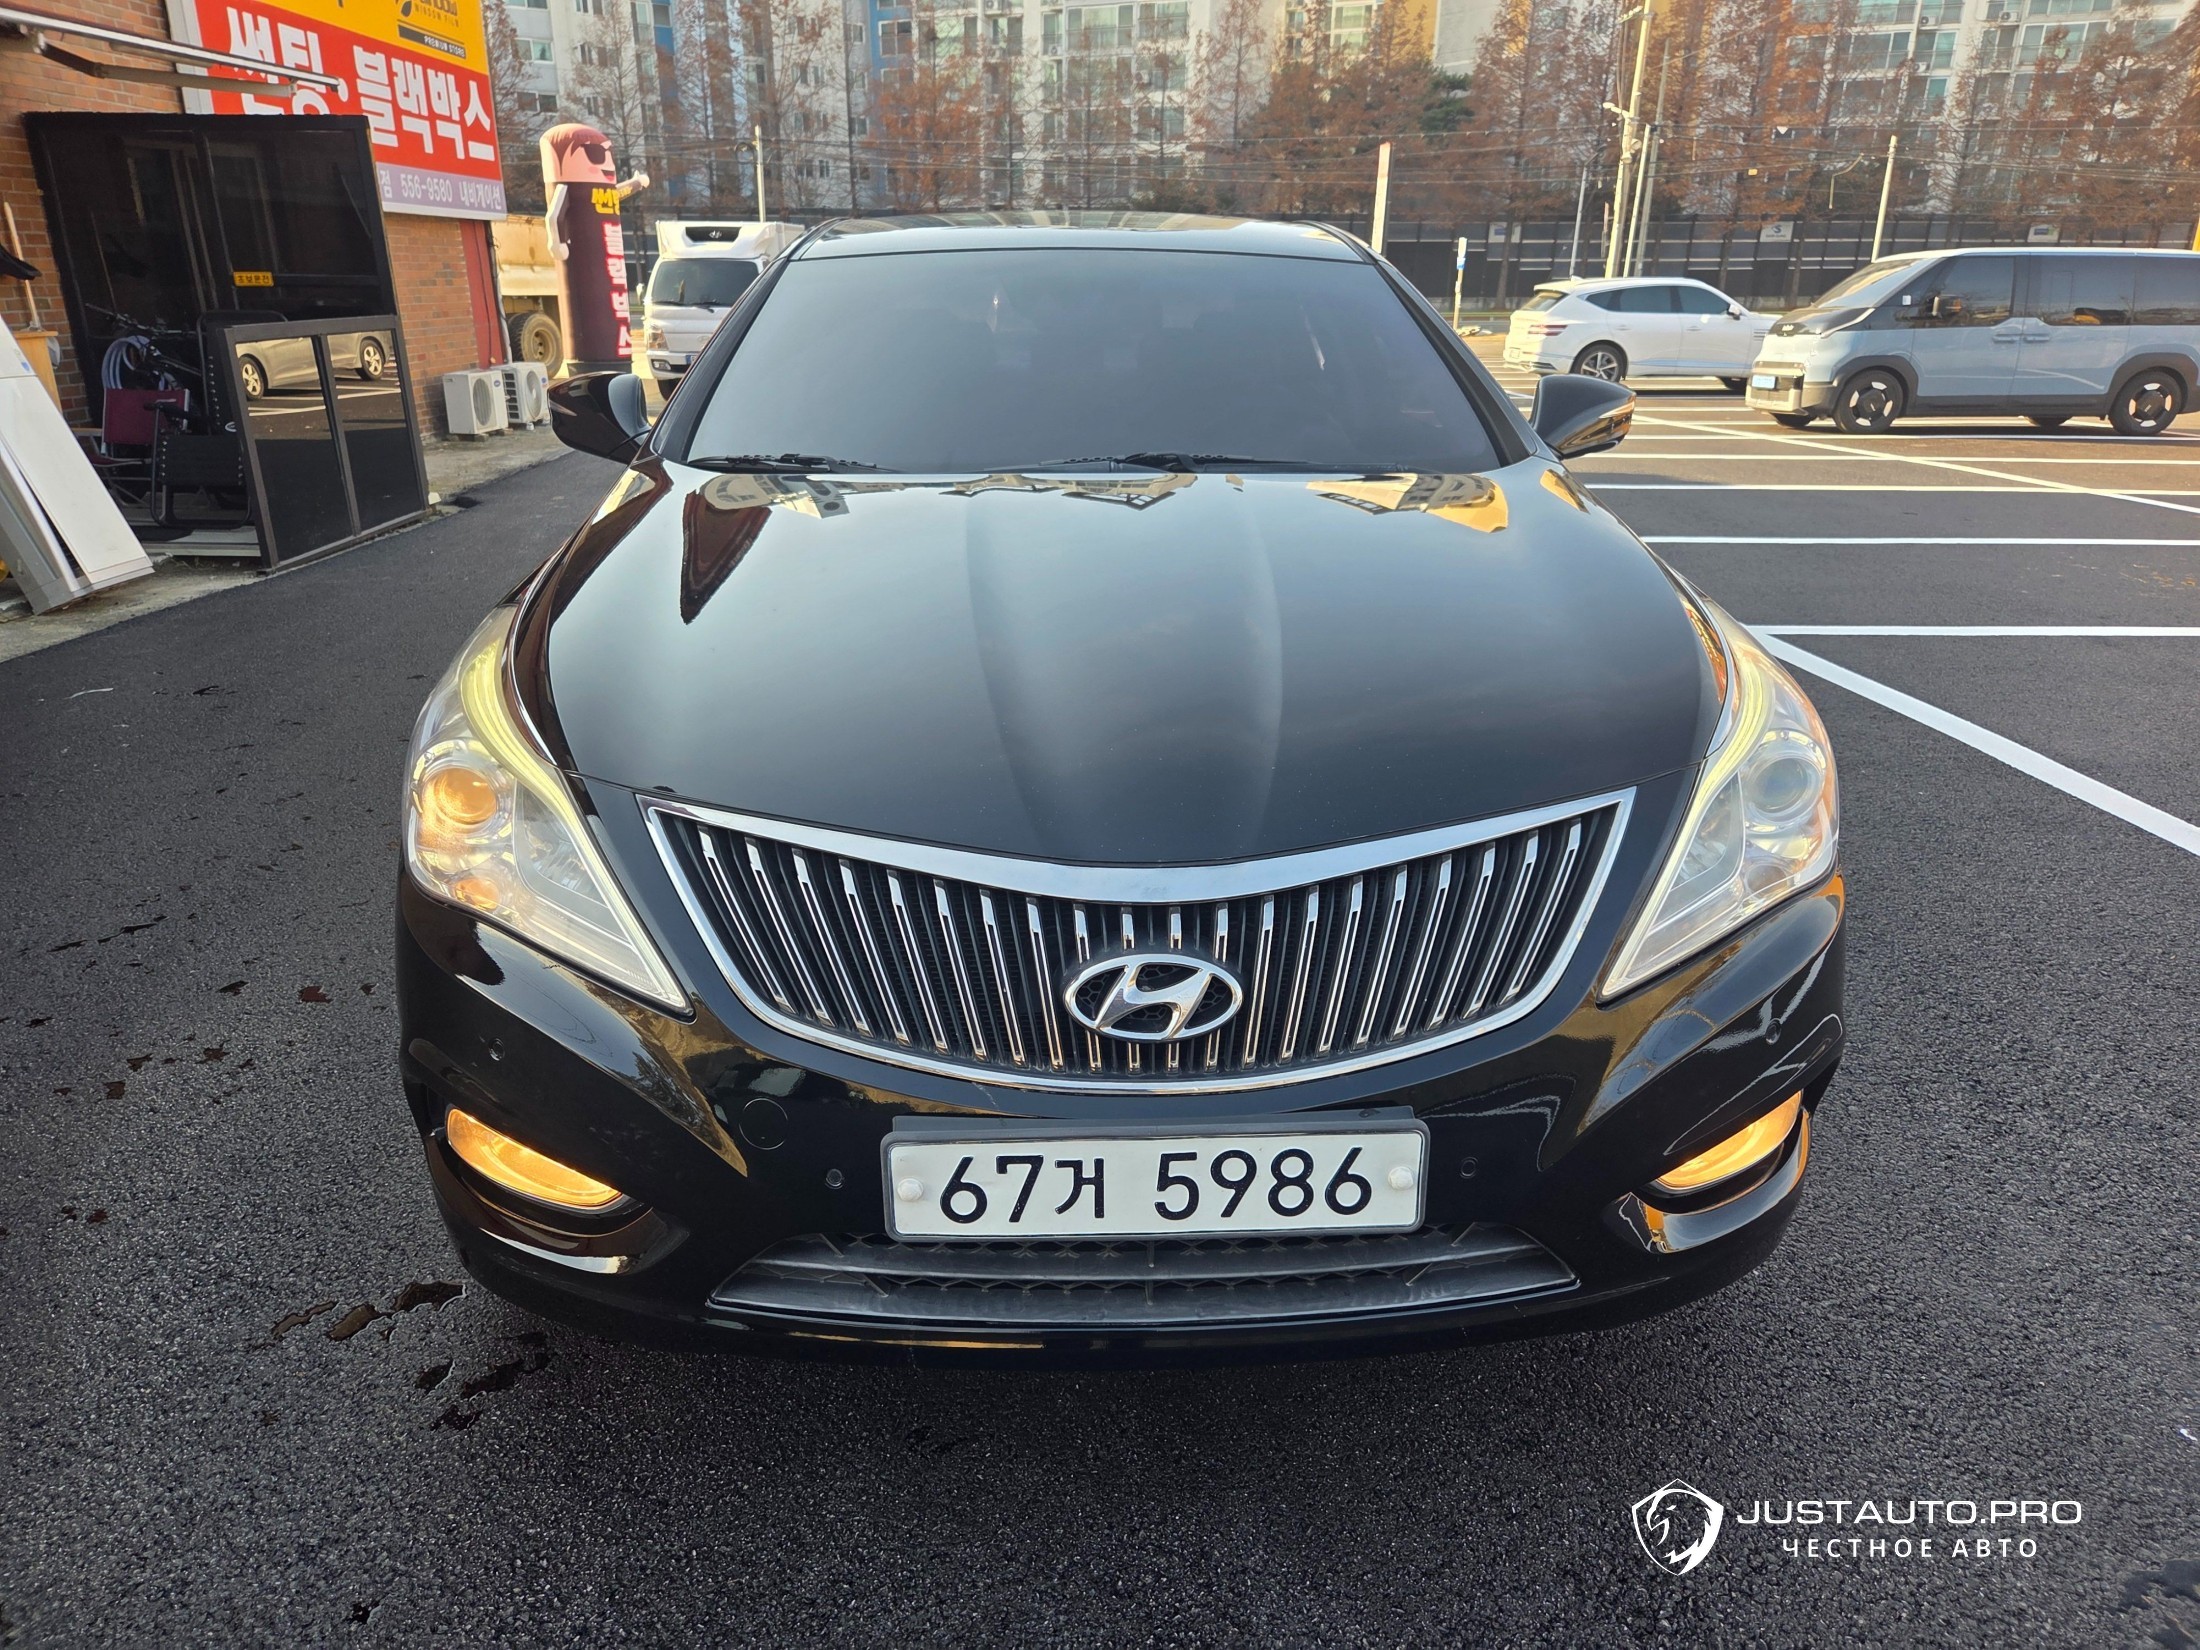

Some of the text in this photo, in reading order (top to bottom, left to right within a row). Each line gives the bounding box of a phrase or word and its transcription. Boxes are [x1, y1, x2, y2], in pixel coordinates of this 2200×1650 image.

[424, 35, 448, 51] PREMIUM
[353, 45, 495, 162] 블랙박스
[401, 173, 453, 203] 556-9580
[459, 181, 502, 210] 내비게이션
[939, 1146, 1373, 1224] 67거 5986
